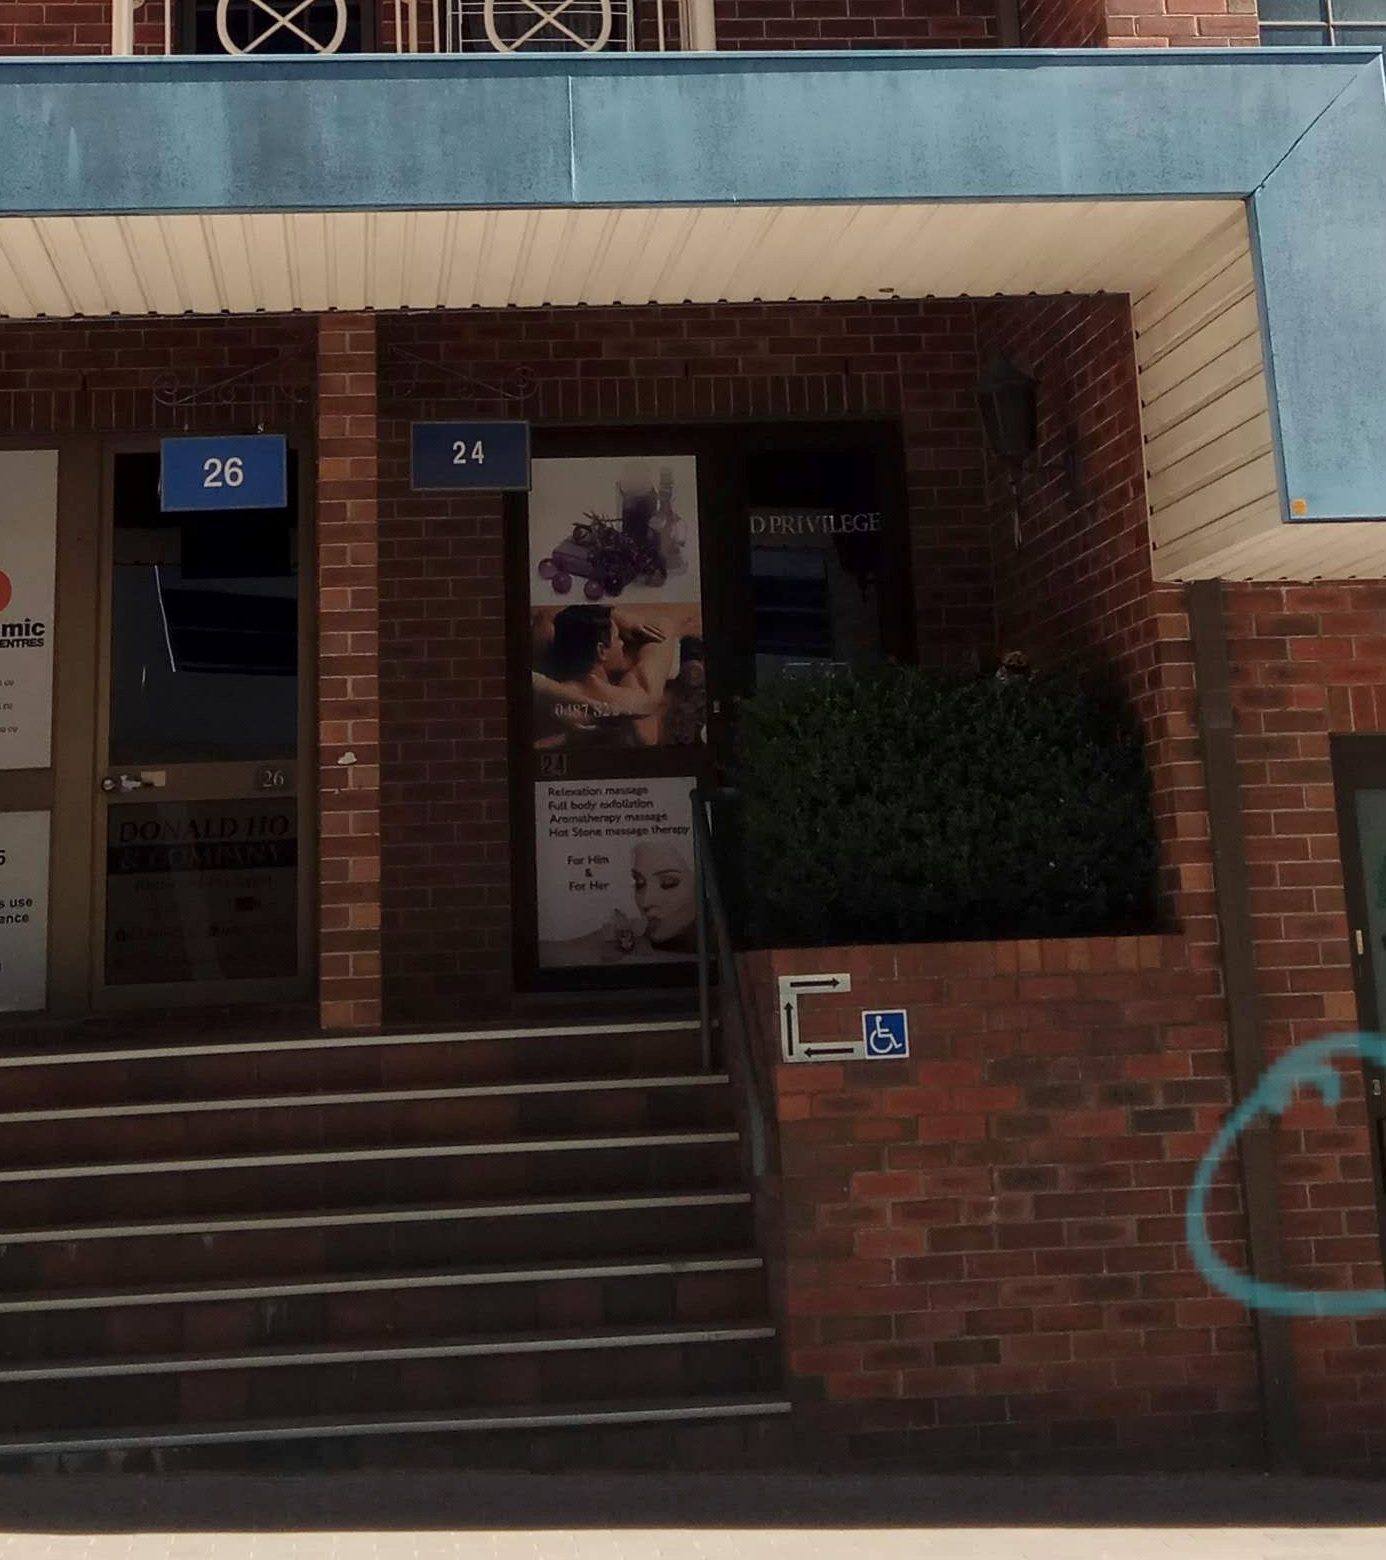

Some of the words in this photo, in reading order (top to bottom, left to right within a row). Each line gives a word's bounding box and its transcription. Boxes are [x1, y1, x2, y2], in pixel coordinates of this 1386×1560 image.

[453, 441, 485, 464] 24
[202, 456, 245, 488] 26
[768, 512, 881, 535] PRIVILEGE
[542, 755, 567, 775] 24
[262, 769, 285, 789] 26
[605, 786, 648, 797] massage
[548, 801, 567, 810] Full
[570, 800, 596, 812] body
[600, 799, 654, 809] exfoliation
[549, 813, 621, 825] Aromatherapy
[624, 812, 668, 823] massage
[120, 815, 238, 841] DONALD
[549, 827, 568, 837] Hot
[572, 826, 602, 837] Stone
[605, 827, 649, 838] massage
[651, 824, 690, 836] therapy
[567, 855, 584, 865] For
[588, 855, 610, 865] Him
[585, 868, 593, 877] &
[569, 881, 586, 891] For
[590, 881, 610, 890] Her
[9, 897, 33, 908] use
